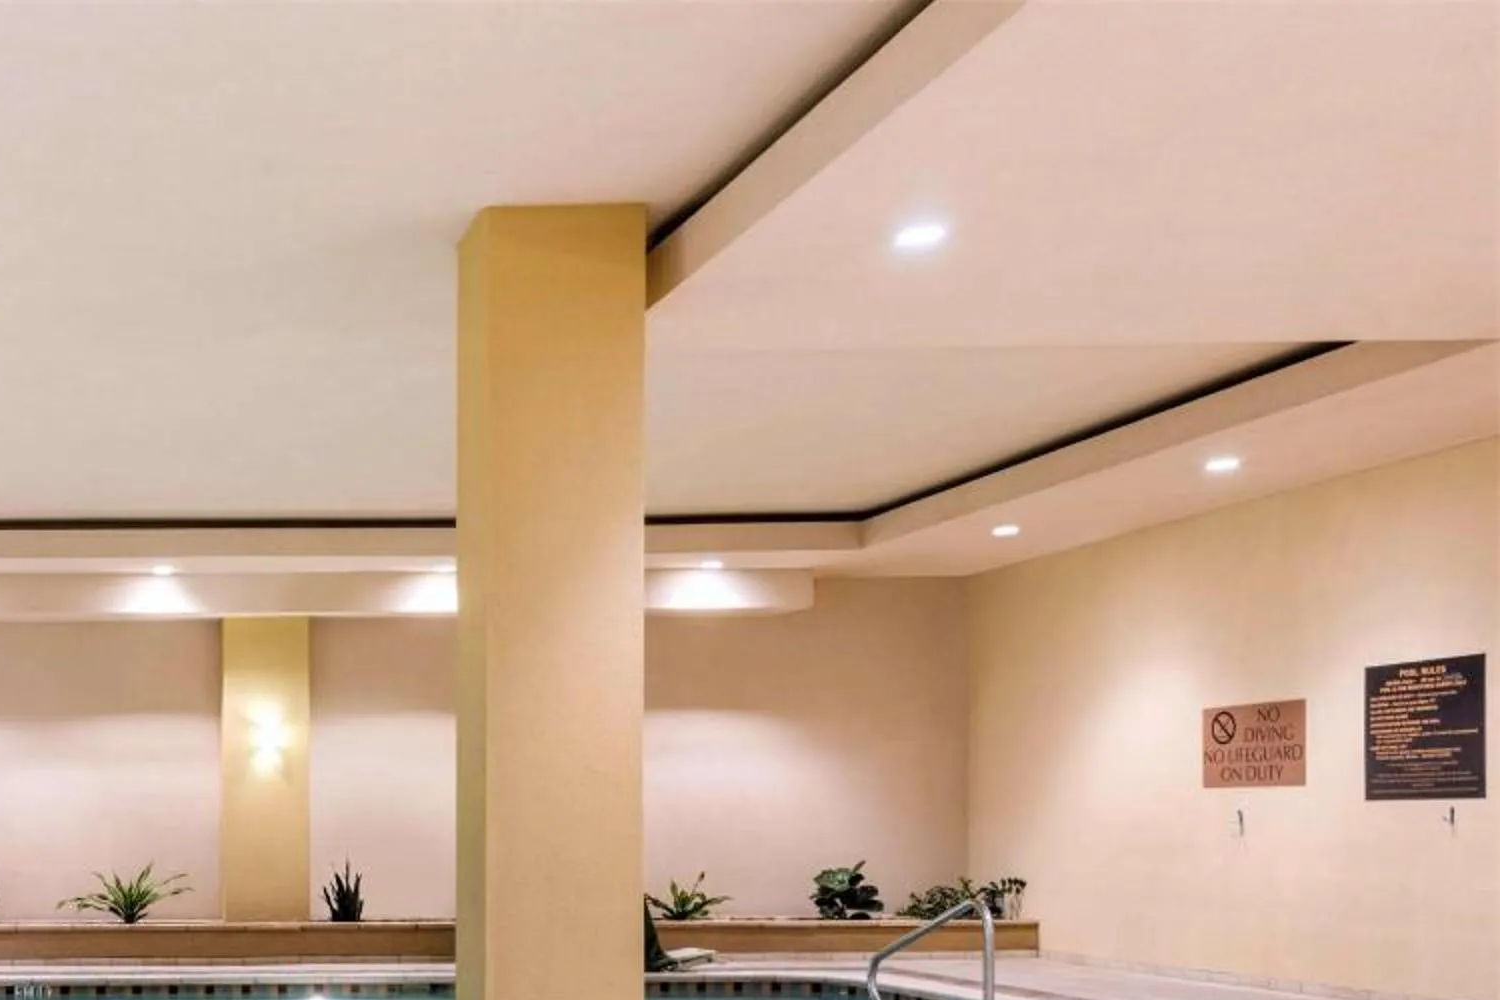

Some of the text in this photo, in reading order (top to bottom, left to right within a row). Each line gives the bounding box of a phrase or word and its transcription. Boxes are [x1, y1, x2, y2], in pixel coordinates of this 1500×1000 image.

[1257, 705, 1280, 722] NO
[1243, 724, 1294, 742] DIVING
[1203, 744, 1303, 765] NO LIFEGUARD
[1220, 764, 1284, 782] ON DUTY
